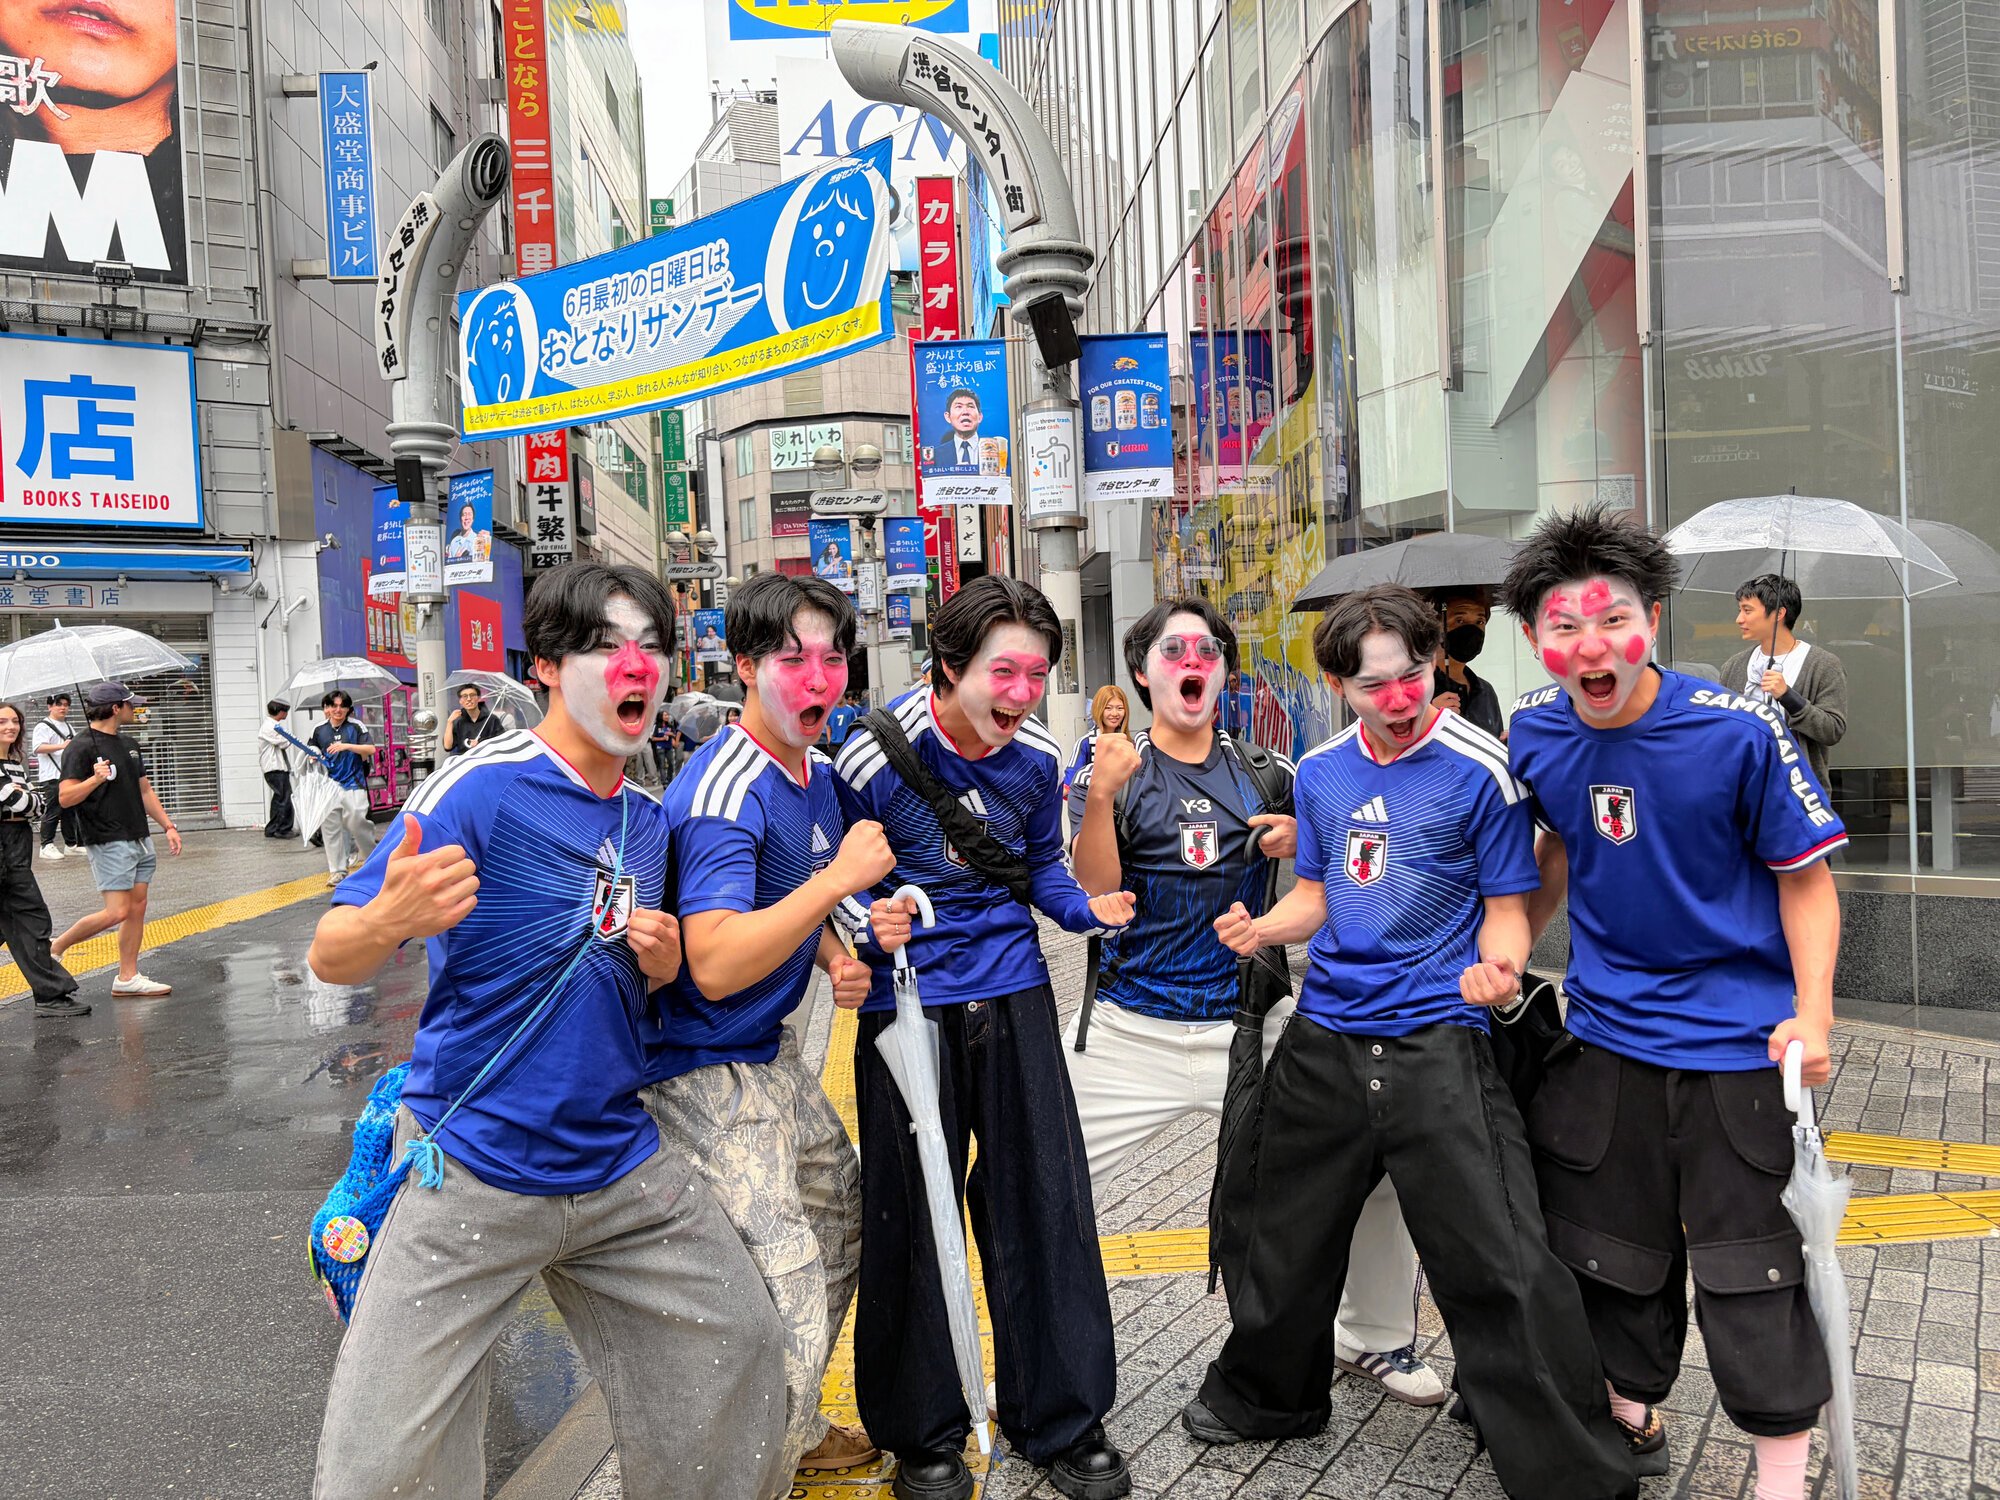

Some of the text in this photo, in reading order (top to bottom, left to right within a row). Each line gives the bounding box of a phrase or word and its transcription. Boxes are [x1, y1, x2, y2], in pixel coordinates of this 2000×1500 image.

[512, 0, 540, 117] ことなら
[912, 51, 1026, 213] 渋谷センター街
[330, 84, 369, 267] 大盛堂商事ビル
[828, 156, 877, 187] 渋谷センター街
[380, 202, 430, 374] 渋谷センター街
[564, 242, 727, 318] 6月最初の日曜日は
[542, 278, 760, 372] おとなりサンデー
[1088, 378, 1164, 395] FOR OUR GREATEST STAGE
[15, 374, 137, 481] 店
[790, 427, 842, 447] れいわ
[530, 432, 562, 479] 焼肉
[1121, 443, 1149, 453] KIRIN
[936, 487, 999, 496] 渋谷センター街
[1096, 478, 1161, 491] 渋谷センター街
[23, 490, 170, 511] BOOKS TAISEIDO
[815, 493, 883, 506] 渋谷センター街
[536, 485, 565, 542] 牛繁
[944, 540, 952, 567] CULTURE
[667, 565, 717, 574] 渋谷センター街
[1510, 686, 1560, 712] BLUE
[837, 714, 845, 726] 7
[1689, 689, 1835, 827] SAMURAI BLUE
[1602, 786, 1624, 795] JAPAN
[1180, 798, 1212, 814] Y-3
[1358, 832, 1379, 840] JAPAN
[1608, 825, 1627, 836] JFA
[1192, 854, 1208, 862] JFA
[1355, 867, 1373, 878] JFA
